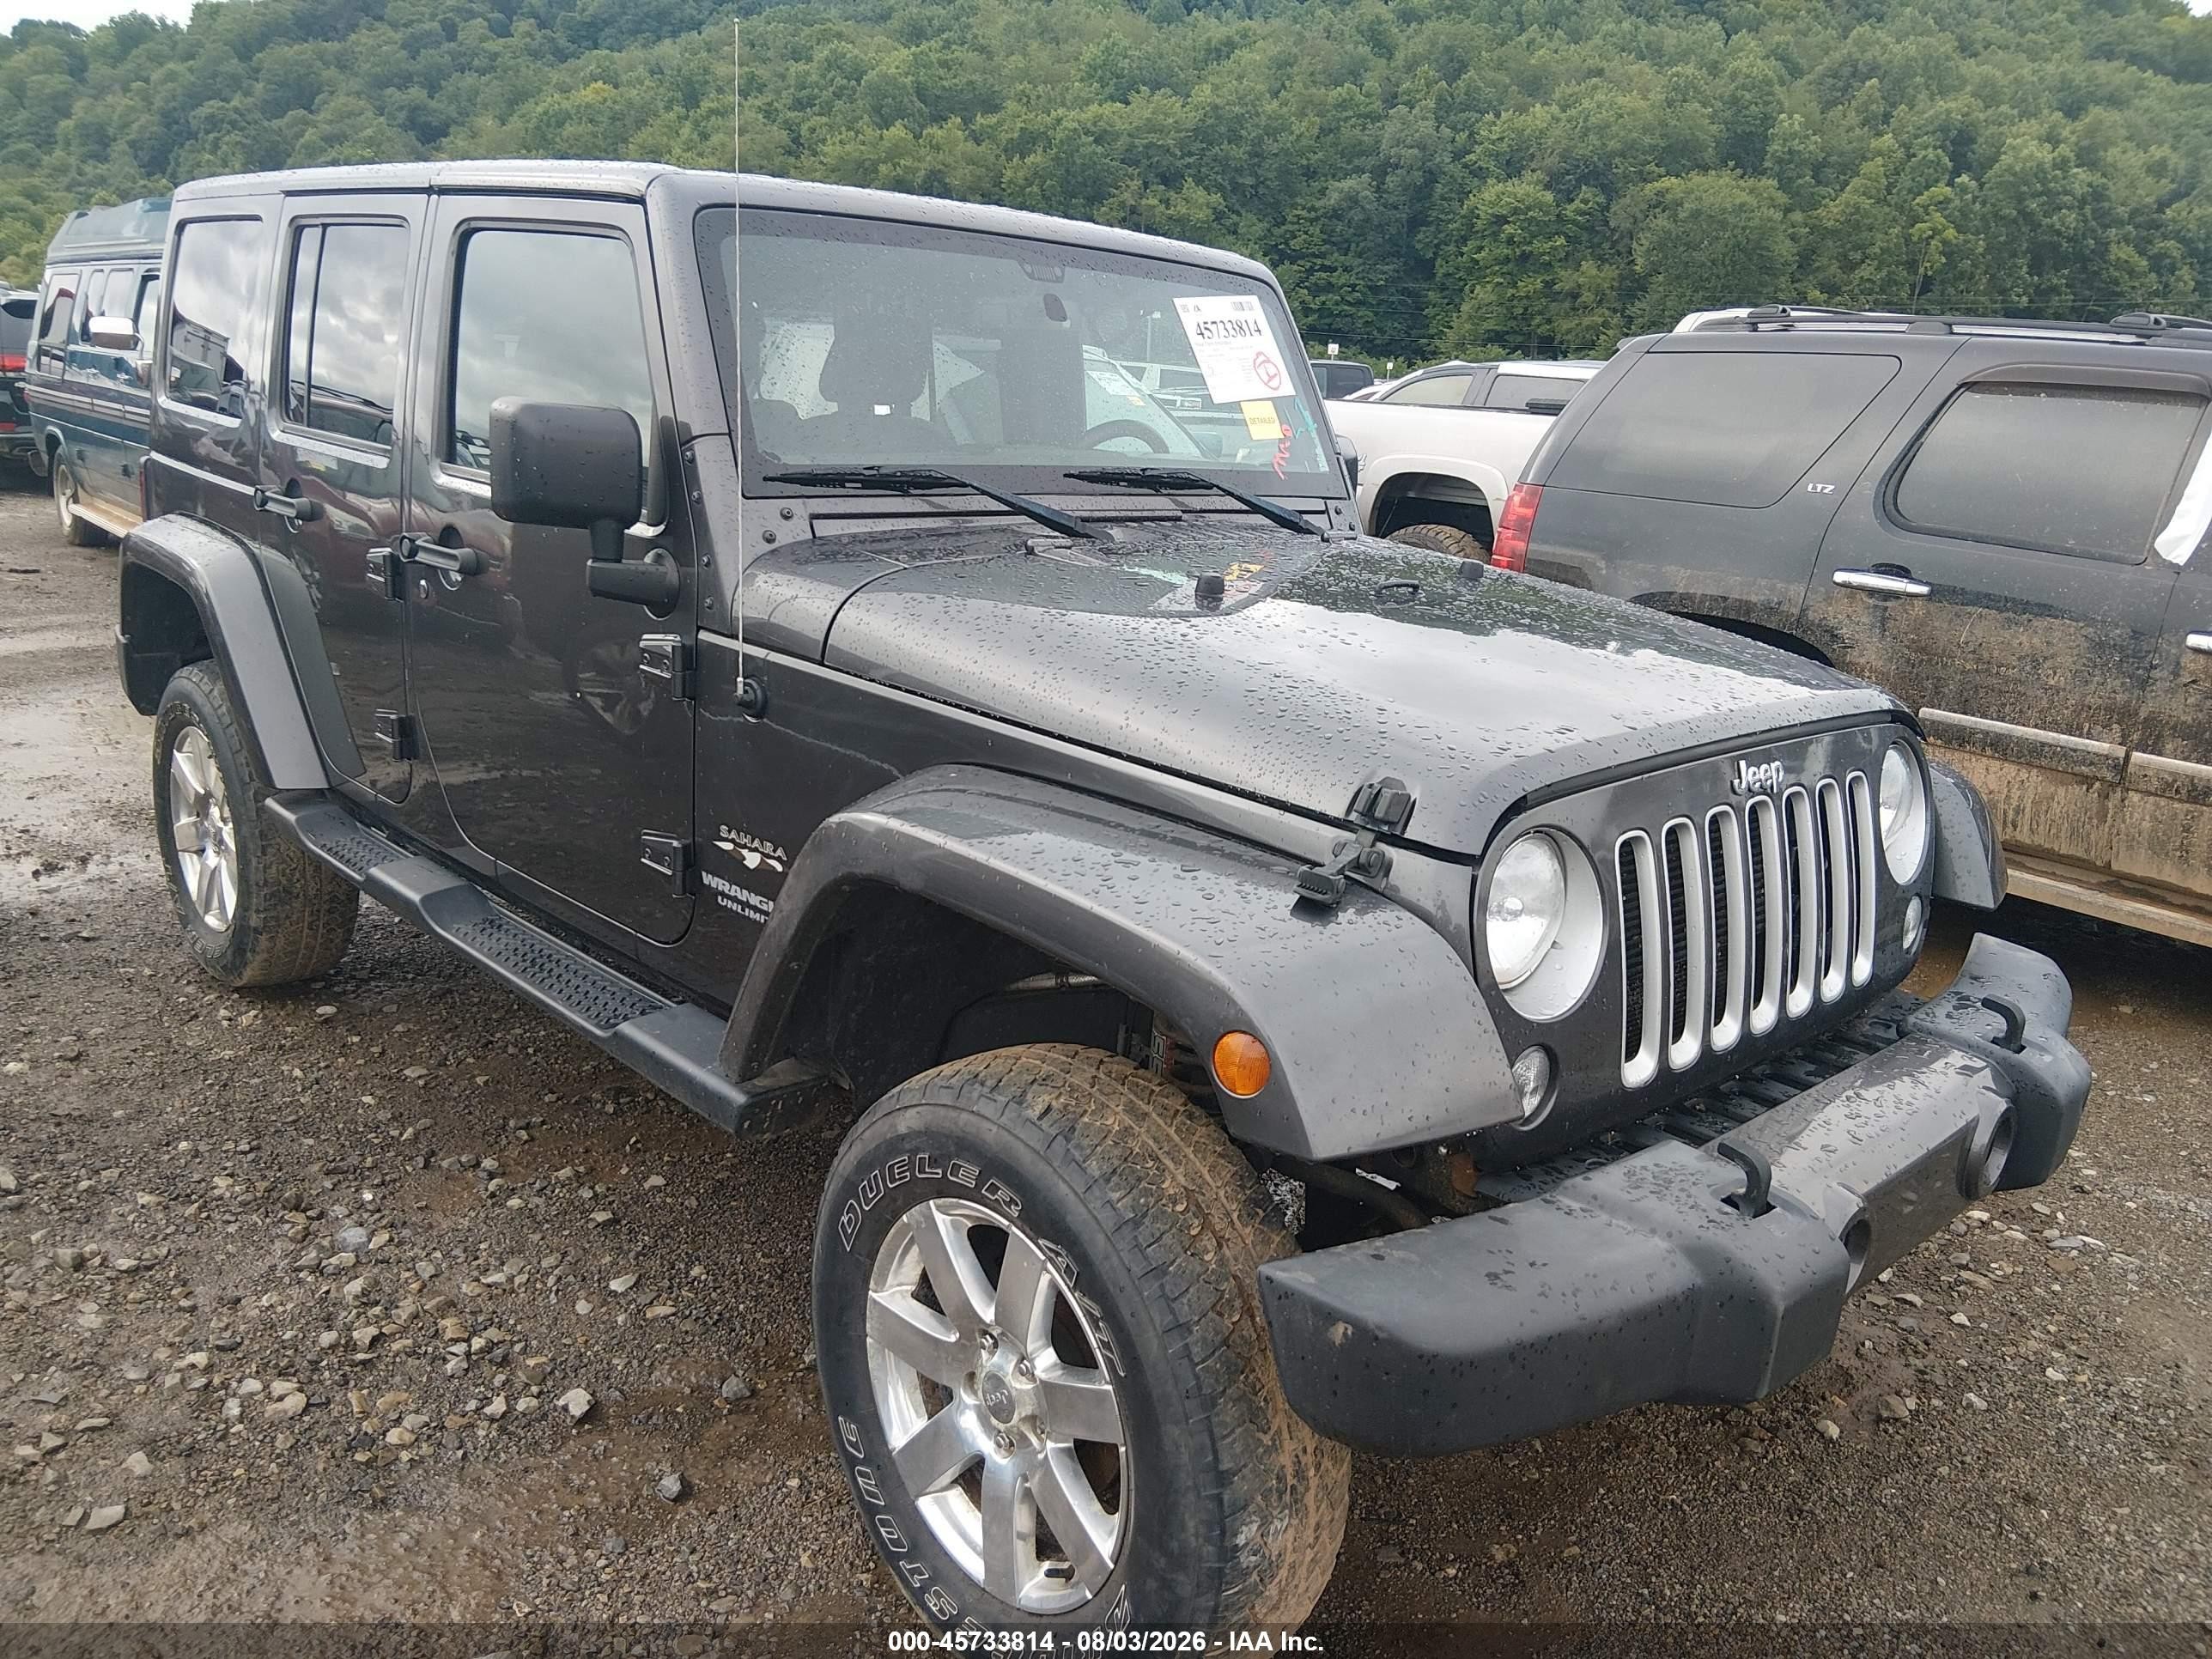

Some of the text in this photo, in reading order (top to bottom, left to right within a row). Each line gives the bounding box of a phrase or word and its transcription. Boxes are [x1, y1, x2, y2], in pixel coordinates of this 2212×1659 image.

[1196, 318, 1262, 339] 45733814
[1807, 483, 1835, 495] LTZ
[1731, 760, 1784, 795] Jeep
[720, 824, 787, 861] SAHARA
[838, 1153, 1023, 1252] DUELER
